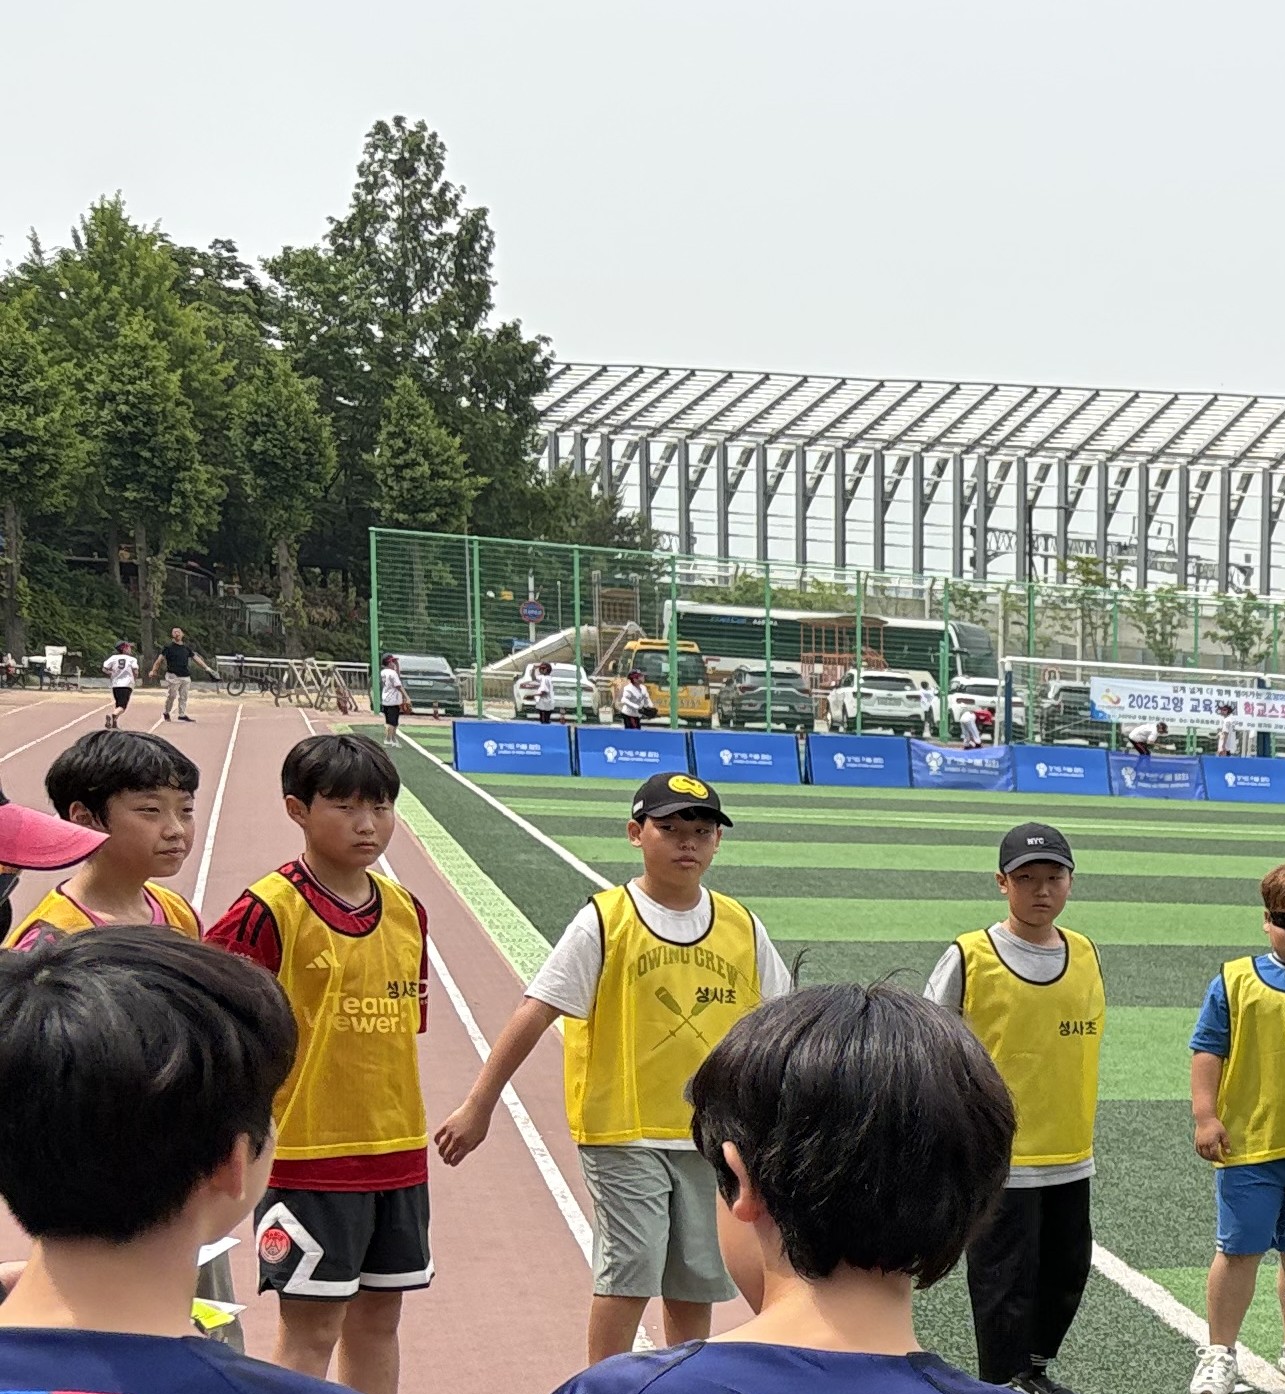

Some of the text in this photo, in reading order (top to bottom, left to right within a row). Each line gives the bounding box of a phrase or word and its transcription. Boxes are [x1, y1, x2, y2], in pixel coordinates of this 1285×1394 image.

[694, 946, 739, 989] CREW
[325, 990, 400, 1015] Team
[694, 986, 737, 1005] 성사초
[302, 1006, 402, 1034] Vewer
[1058, 1020, 1098, 1037] 성사초
